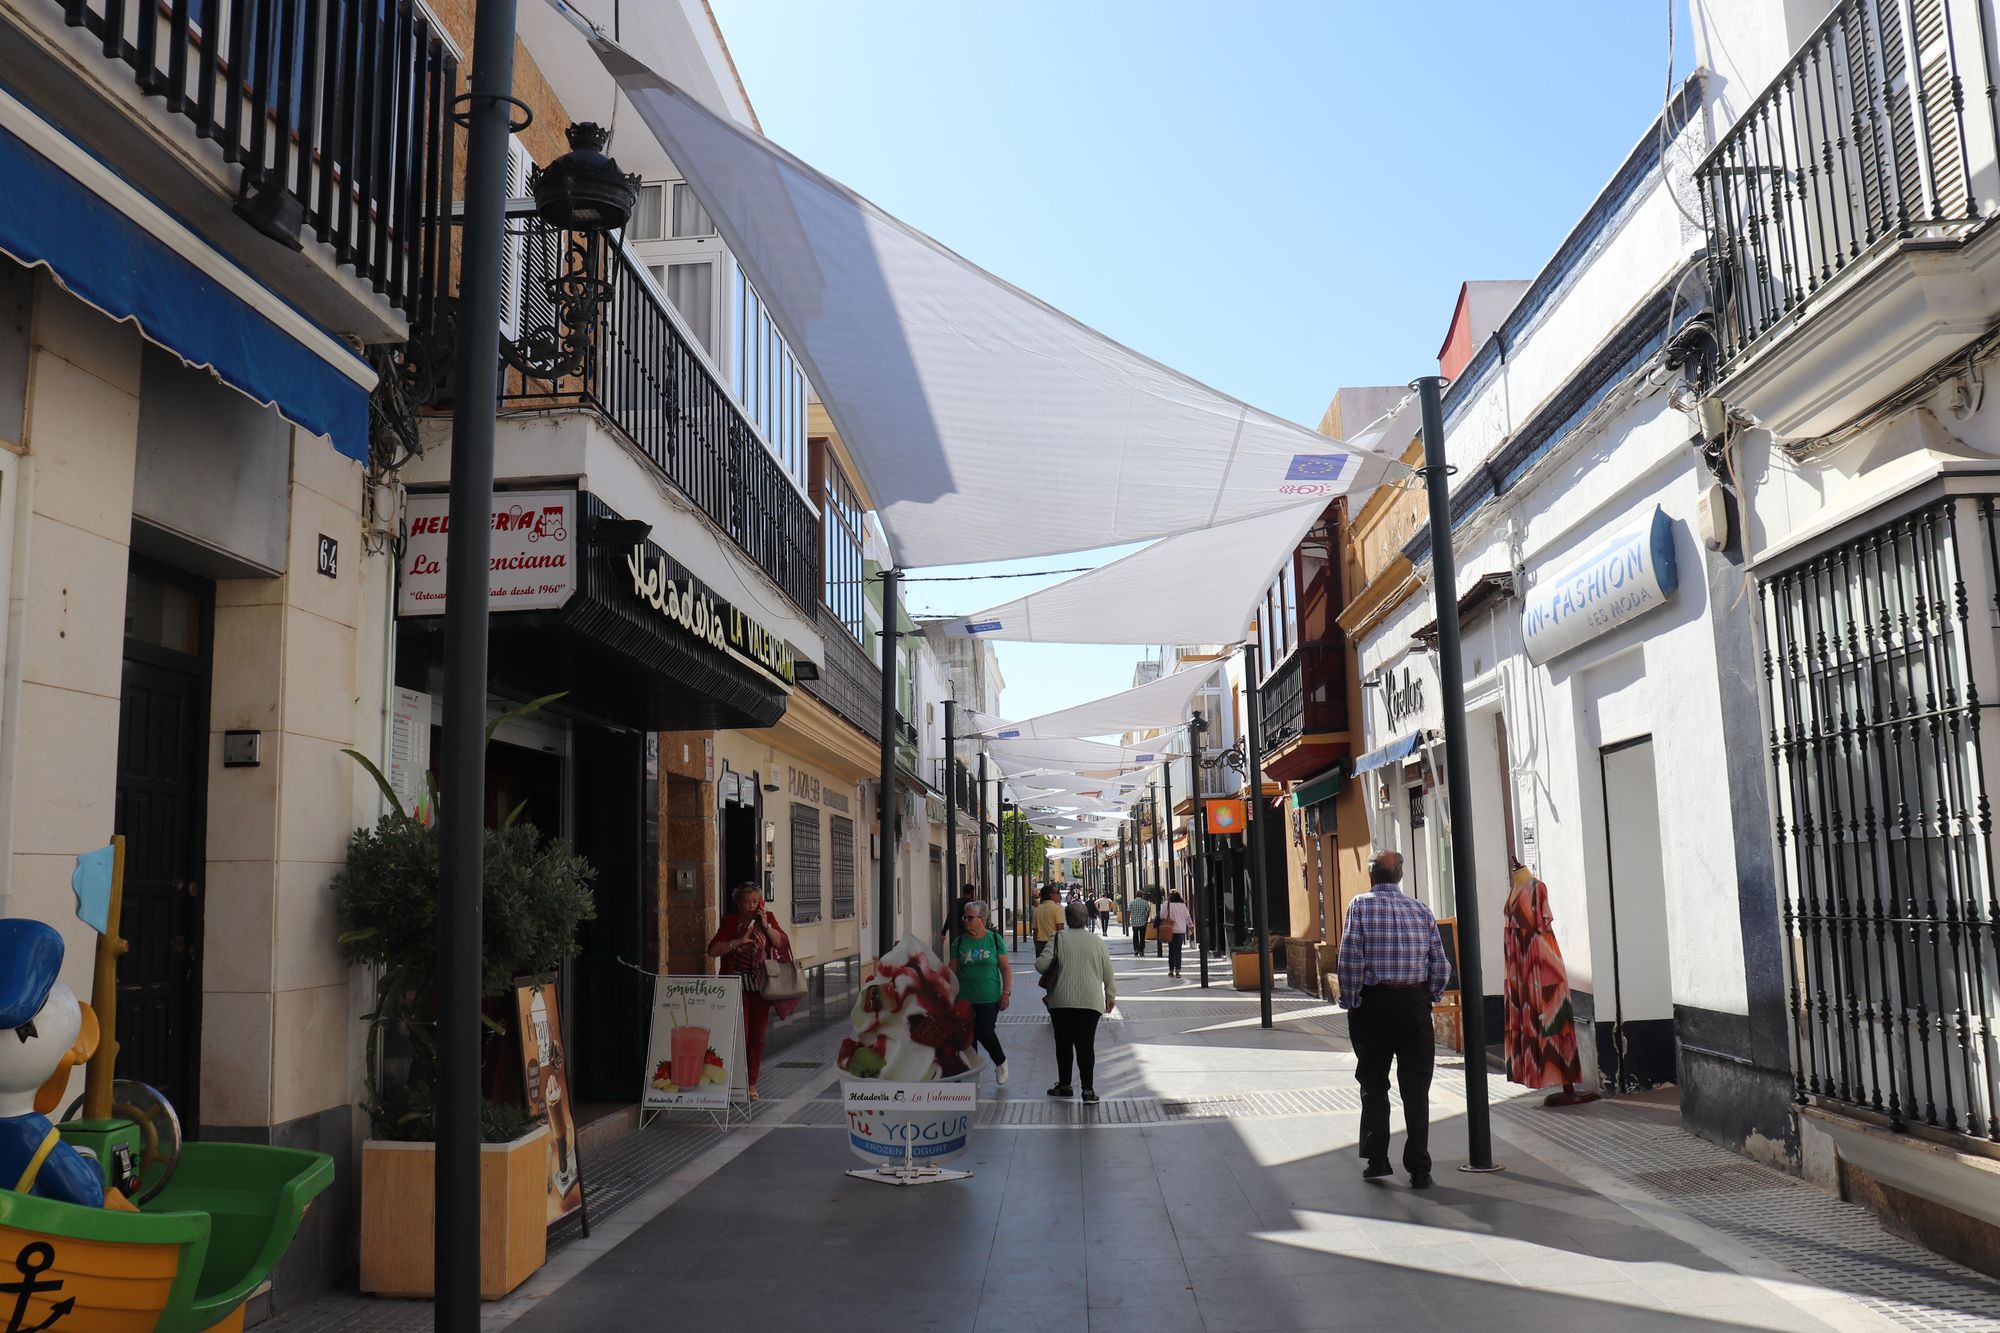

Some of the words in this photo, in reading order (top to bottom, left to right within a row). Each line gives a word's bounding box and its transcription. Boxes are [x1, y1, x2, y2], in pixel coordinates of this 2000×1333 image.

[320, 539, 337, 575] 64
[409, 555, 440, 575] La
[447, 552, 567, 572] enciana
[511, 586, 535, 596] desde
[1527, 543, 1644, 638] IN-FASHION
[1611, 587, 1653, 618] MODA
[730, 603, 743, 648] LA
[747, 614, 796, 686] VALENCIANA
[665, 979, 727, 998] smoothies
[911, 1093, 922, 1103] La
[926, 1091, 972, 1103] Valenciana
[882, 1115, 967, 1141] YOGUR
[865, 1143, 903, 1156] FROZEN
[911, 1143, 949, 1156] OGURT
